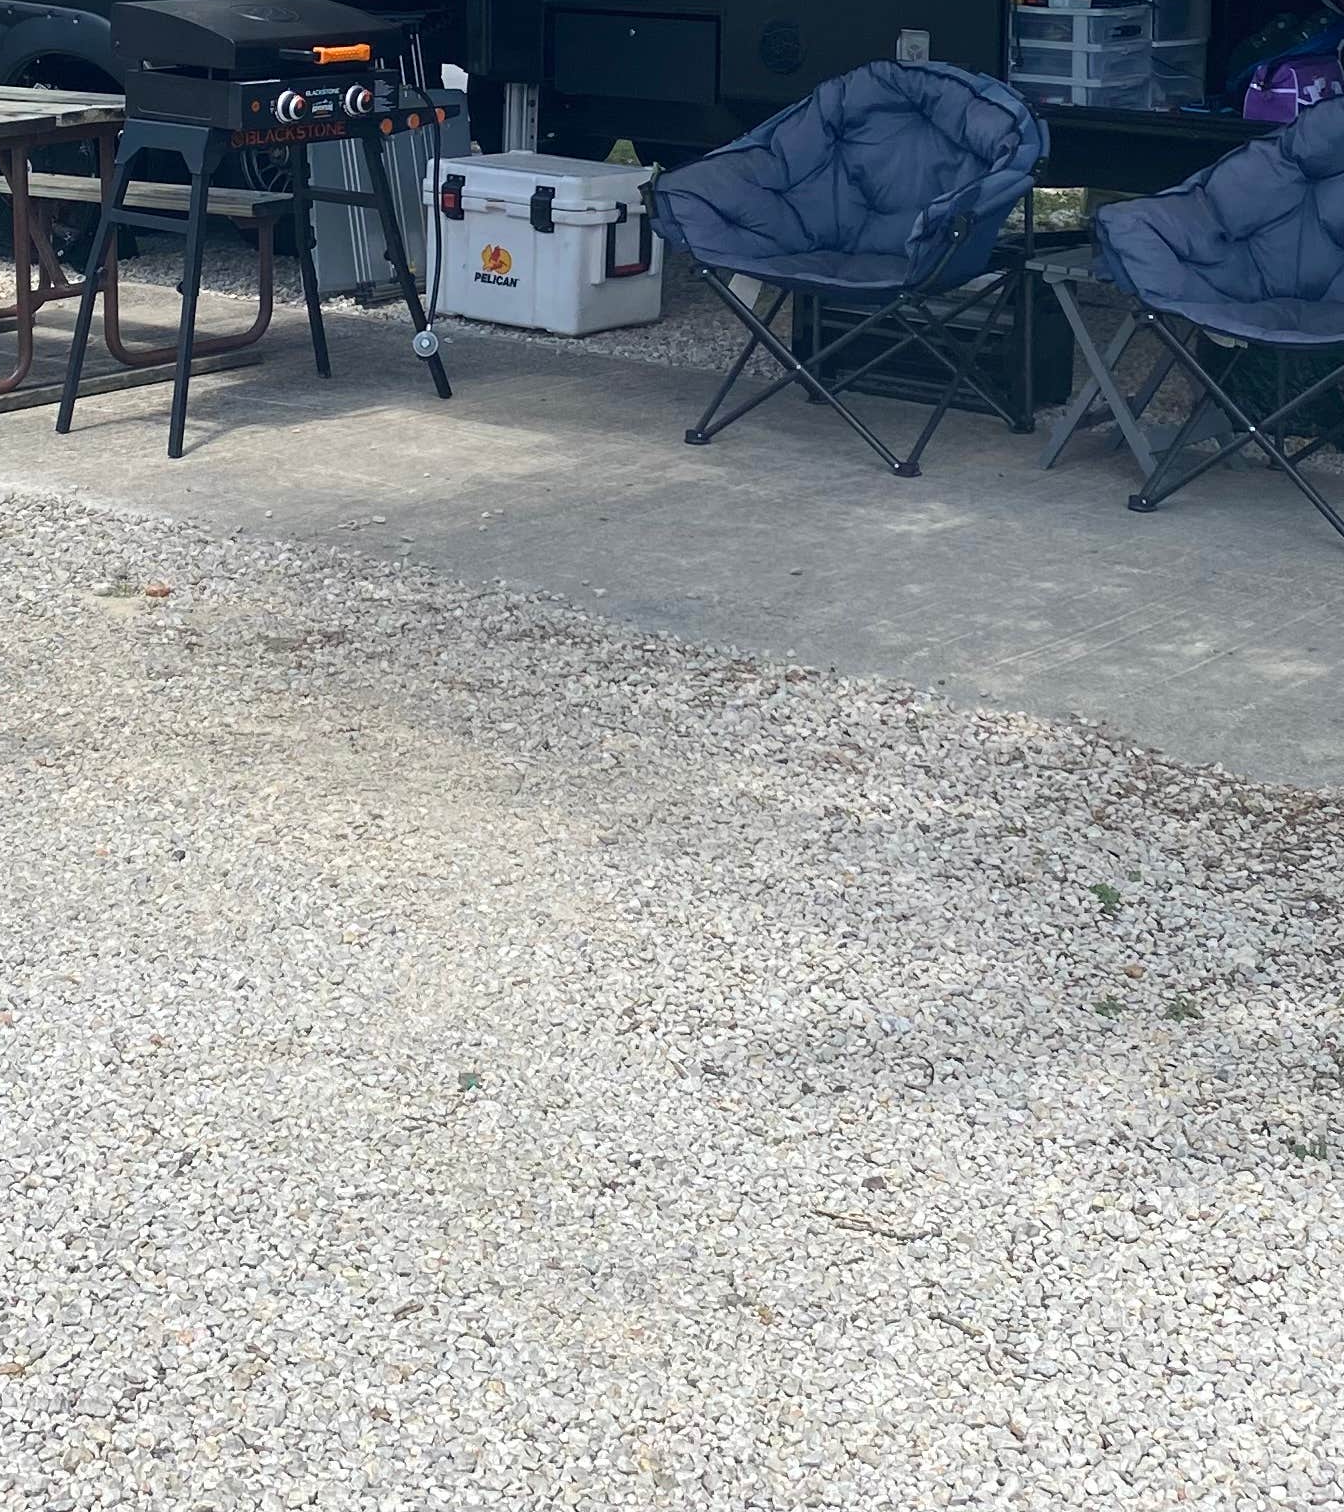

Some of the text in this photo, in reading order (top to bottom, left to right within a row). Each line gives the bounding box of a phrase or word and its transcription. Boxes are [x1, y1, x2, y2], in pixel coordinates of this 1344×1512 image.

[305, 87, 341, 97] BLACKSTONE
[245, 121, 346, 145] BLACKSTONE
[473, 272, 518, 288] PELICAN
